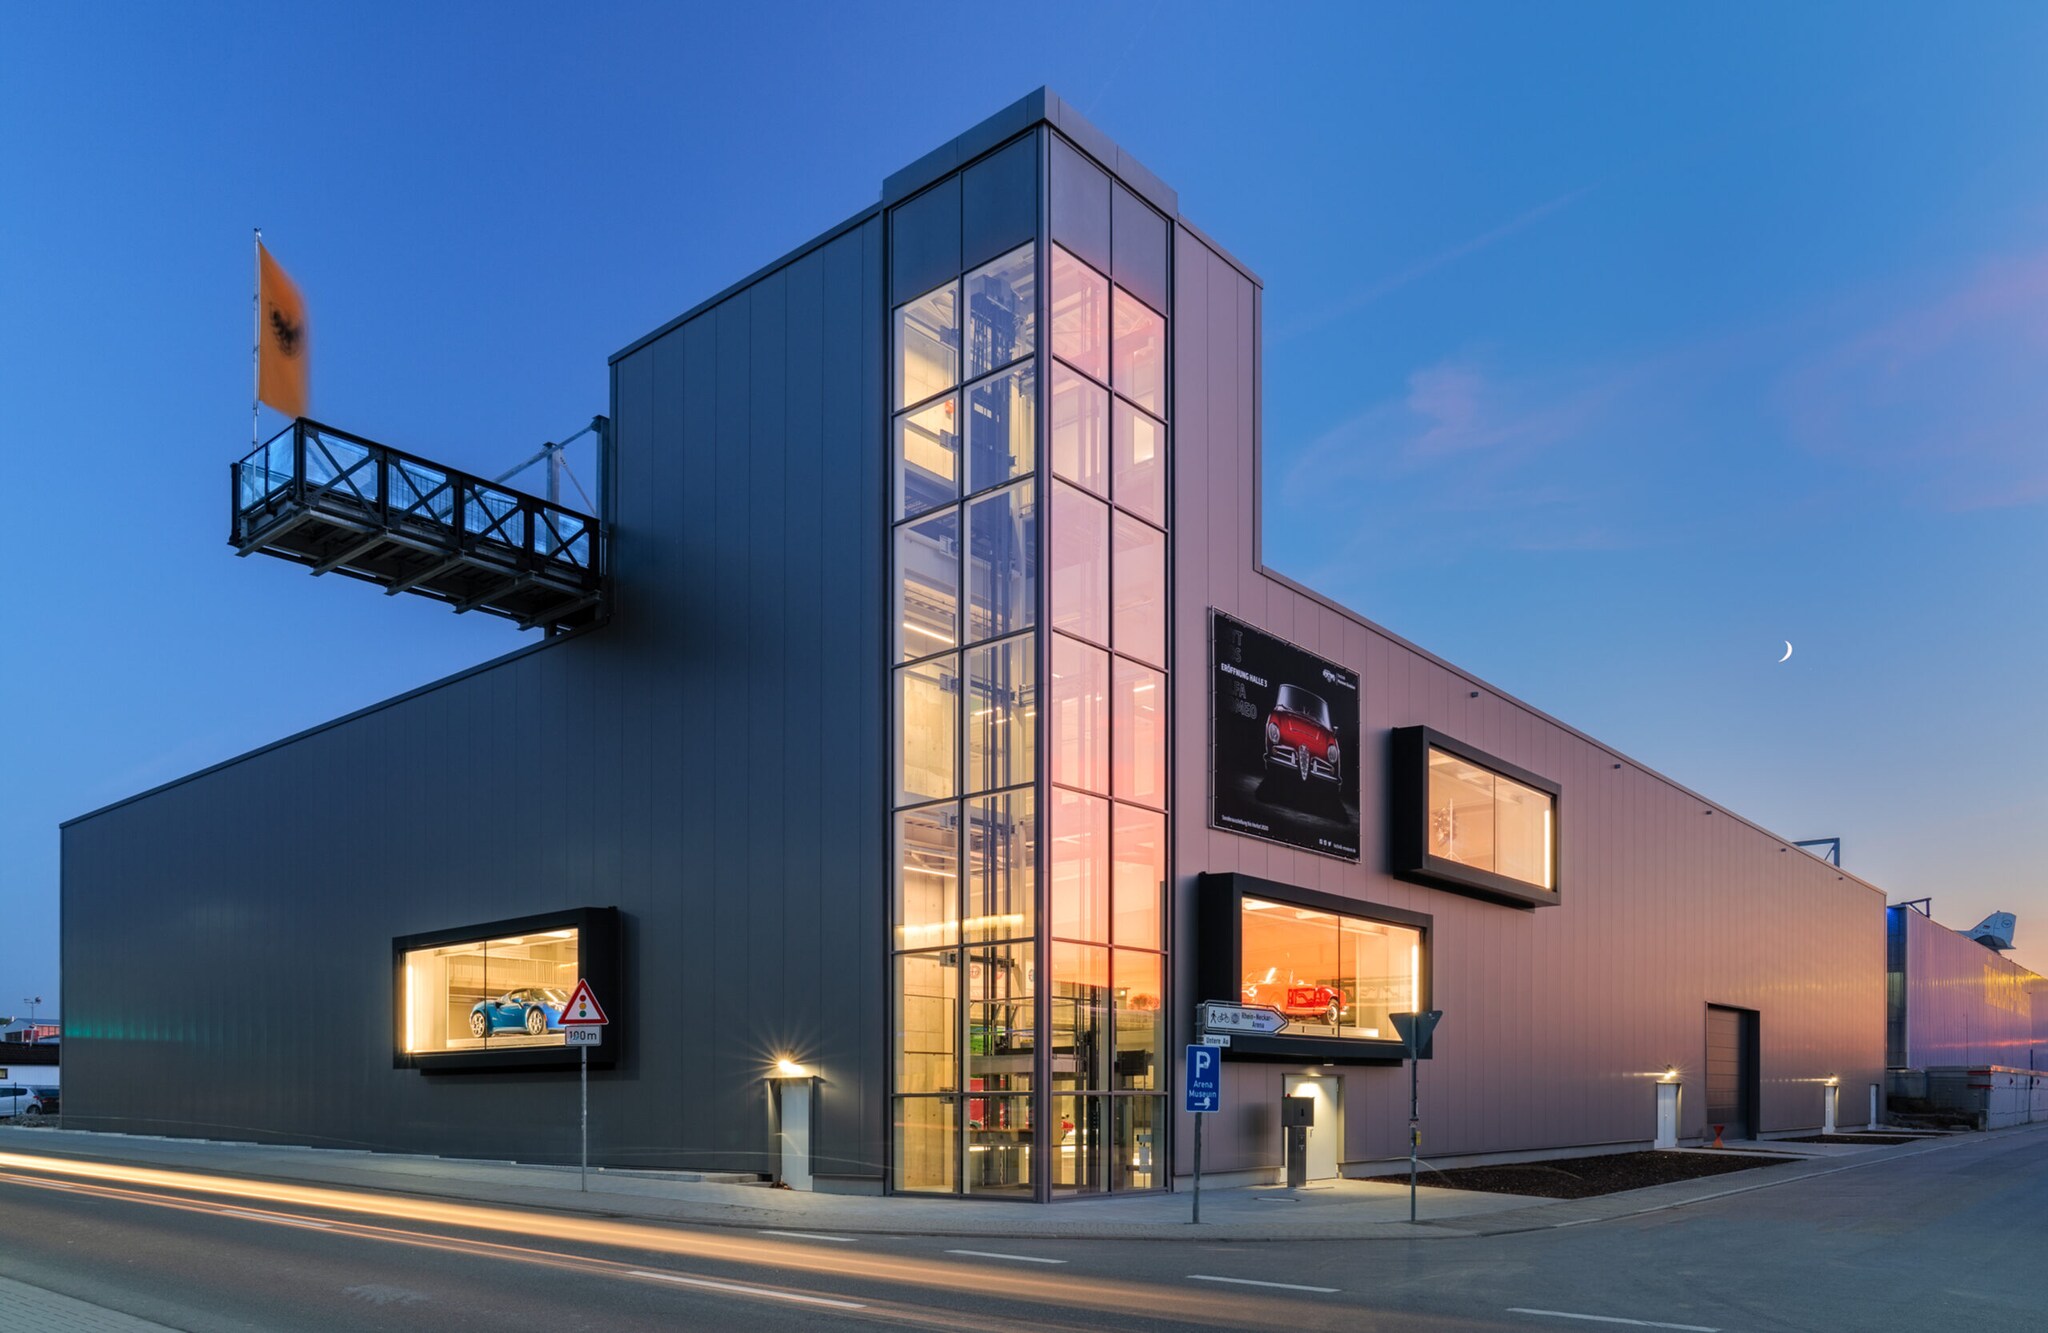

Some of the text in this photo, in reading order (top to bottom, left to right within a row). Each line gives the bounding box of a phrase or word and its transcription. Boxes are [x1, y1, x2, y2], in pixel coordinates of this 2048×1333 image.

[1221, 663, 1250, 681] ERÖFFNUNG
[1250, 673, 1265, 686] HALLE
[1206, 1037, 1221, 1045] Untere
[1195, 1051, 1211, 1078] P
[1193, 1080, 1213, 1088] Arena
[1188, 1089, 1217, 1098] Museum
